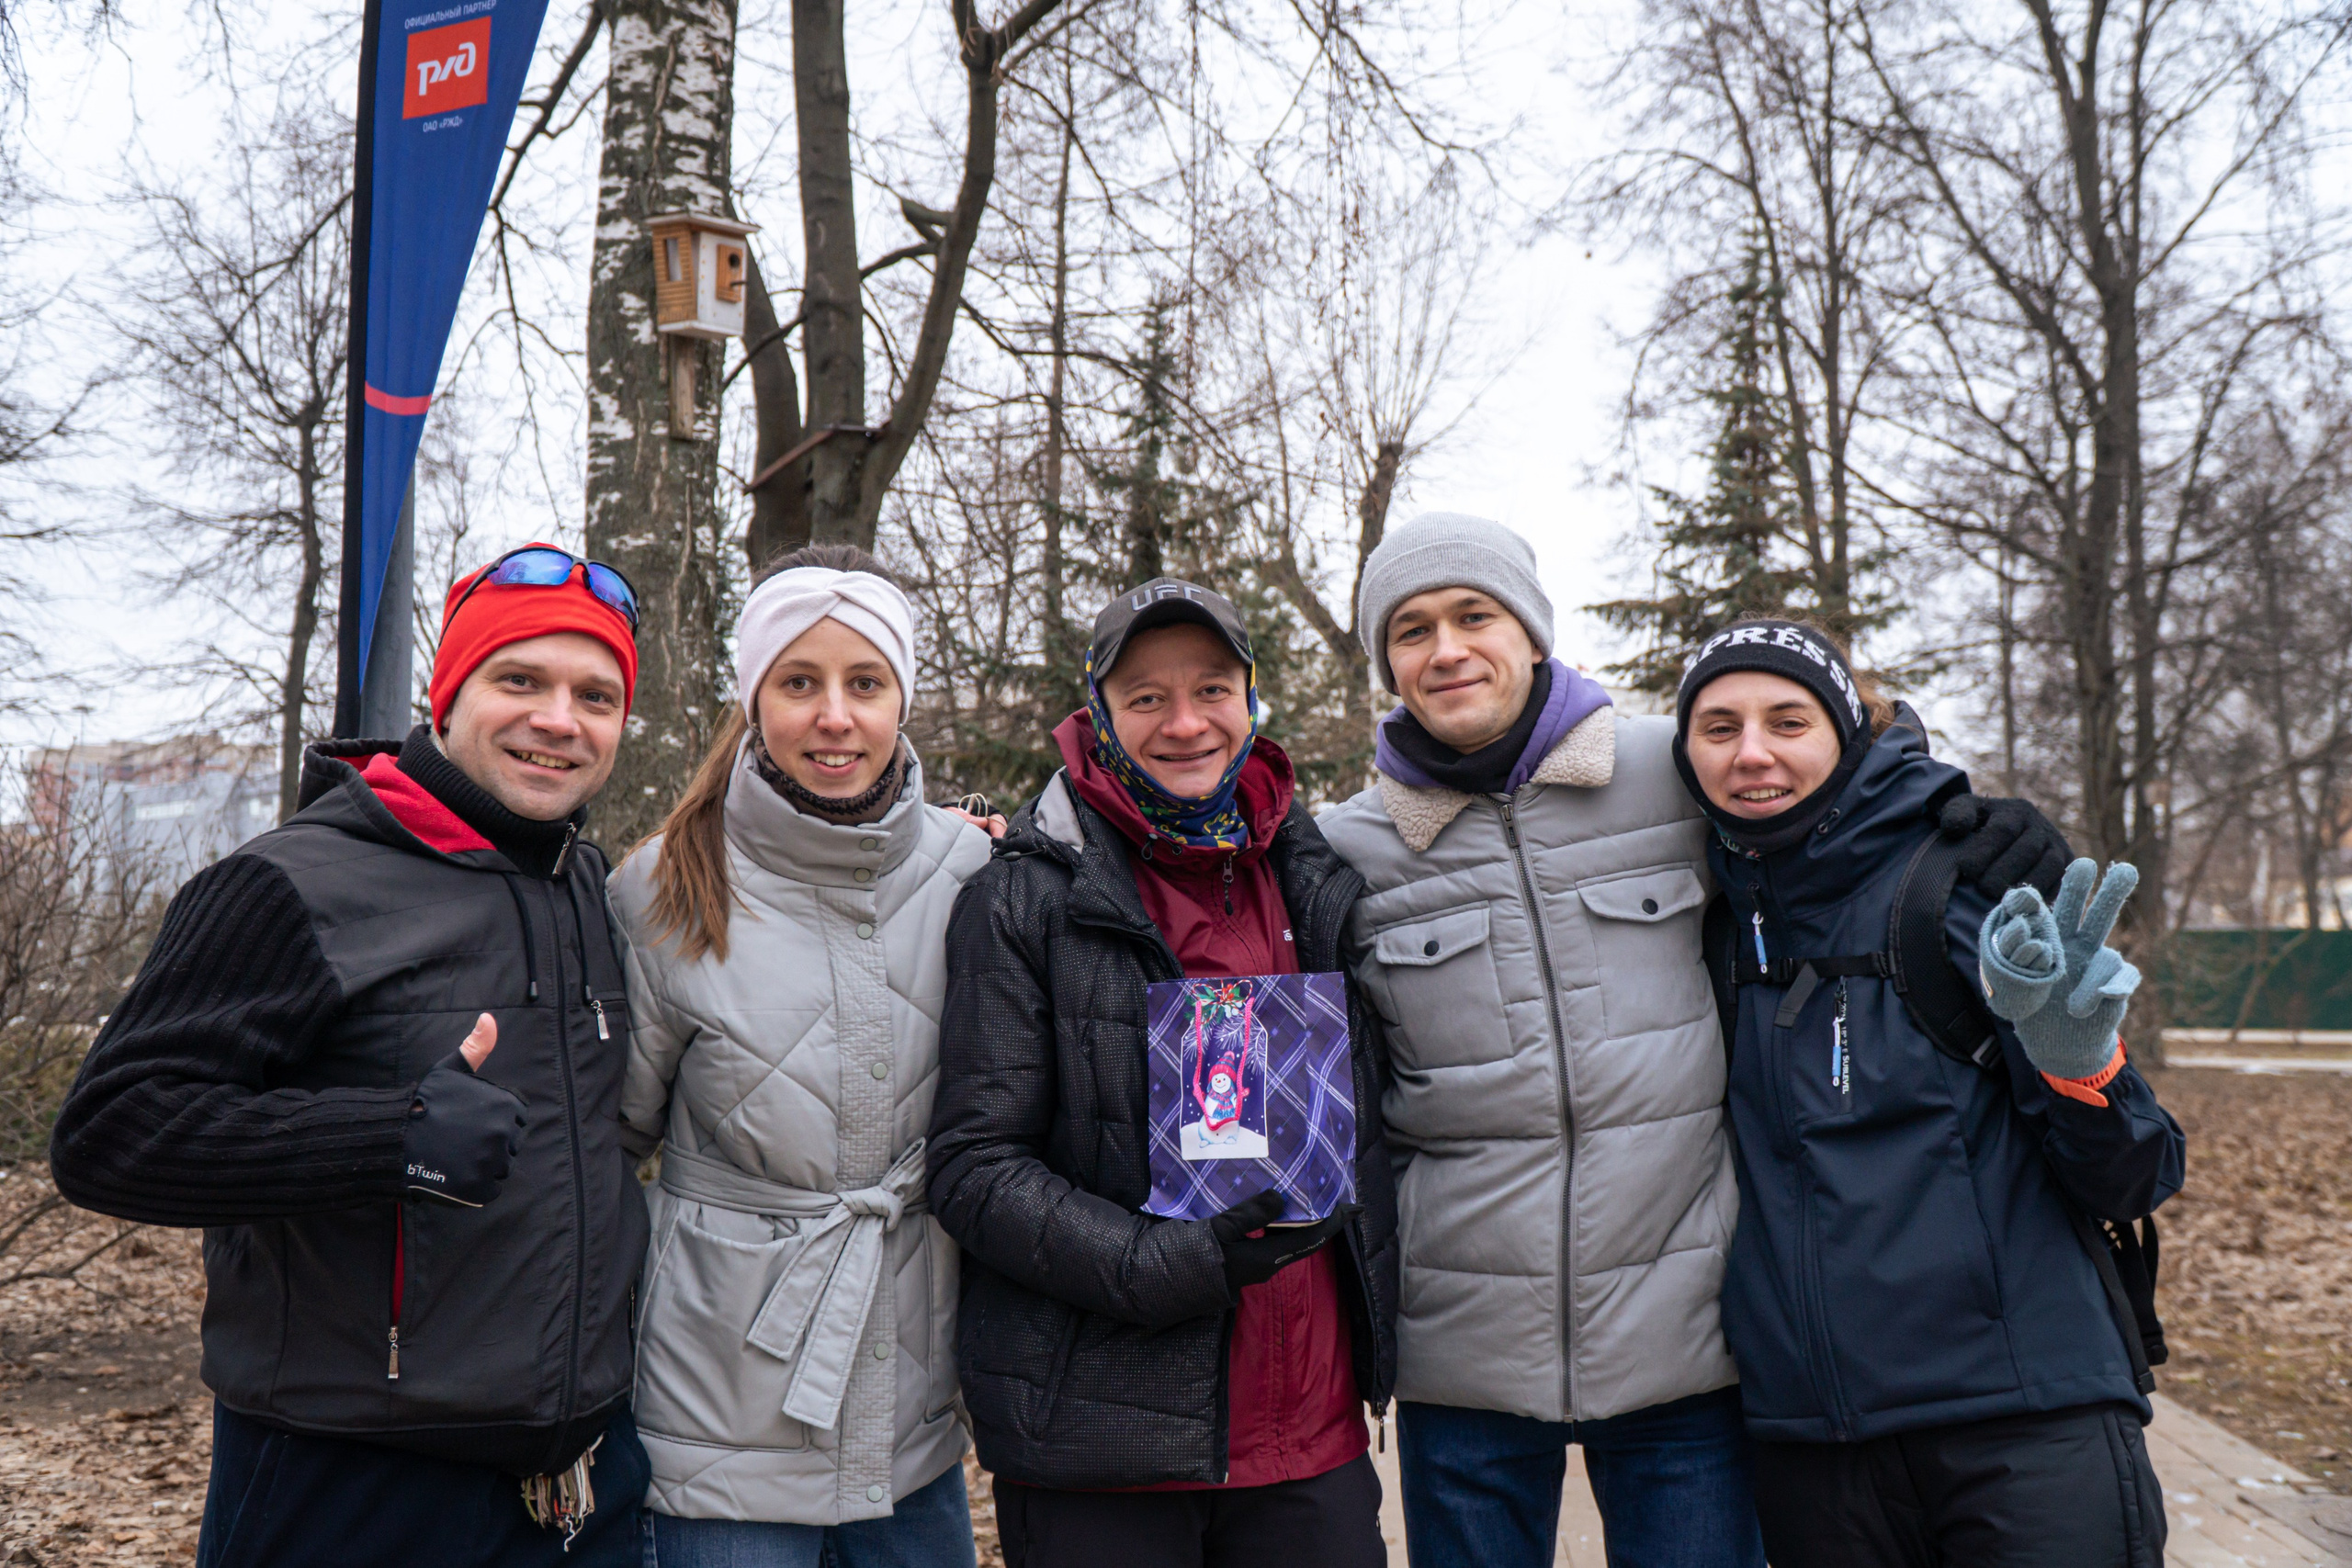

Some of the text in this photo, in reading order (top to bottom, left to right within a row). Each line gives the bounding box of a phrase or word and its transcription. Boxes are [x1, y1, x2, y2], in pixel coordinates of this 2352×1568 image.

[404, 0, 497, 29] ОФИЦИАЛЬНЫЙ ПАРТНЕР
[423, 119, 437, 133] ОАО
[1131, 584, 1204, 612] UFC
